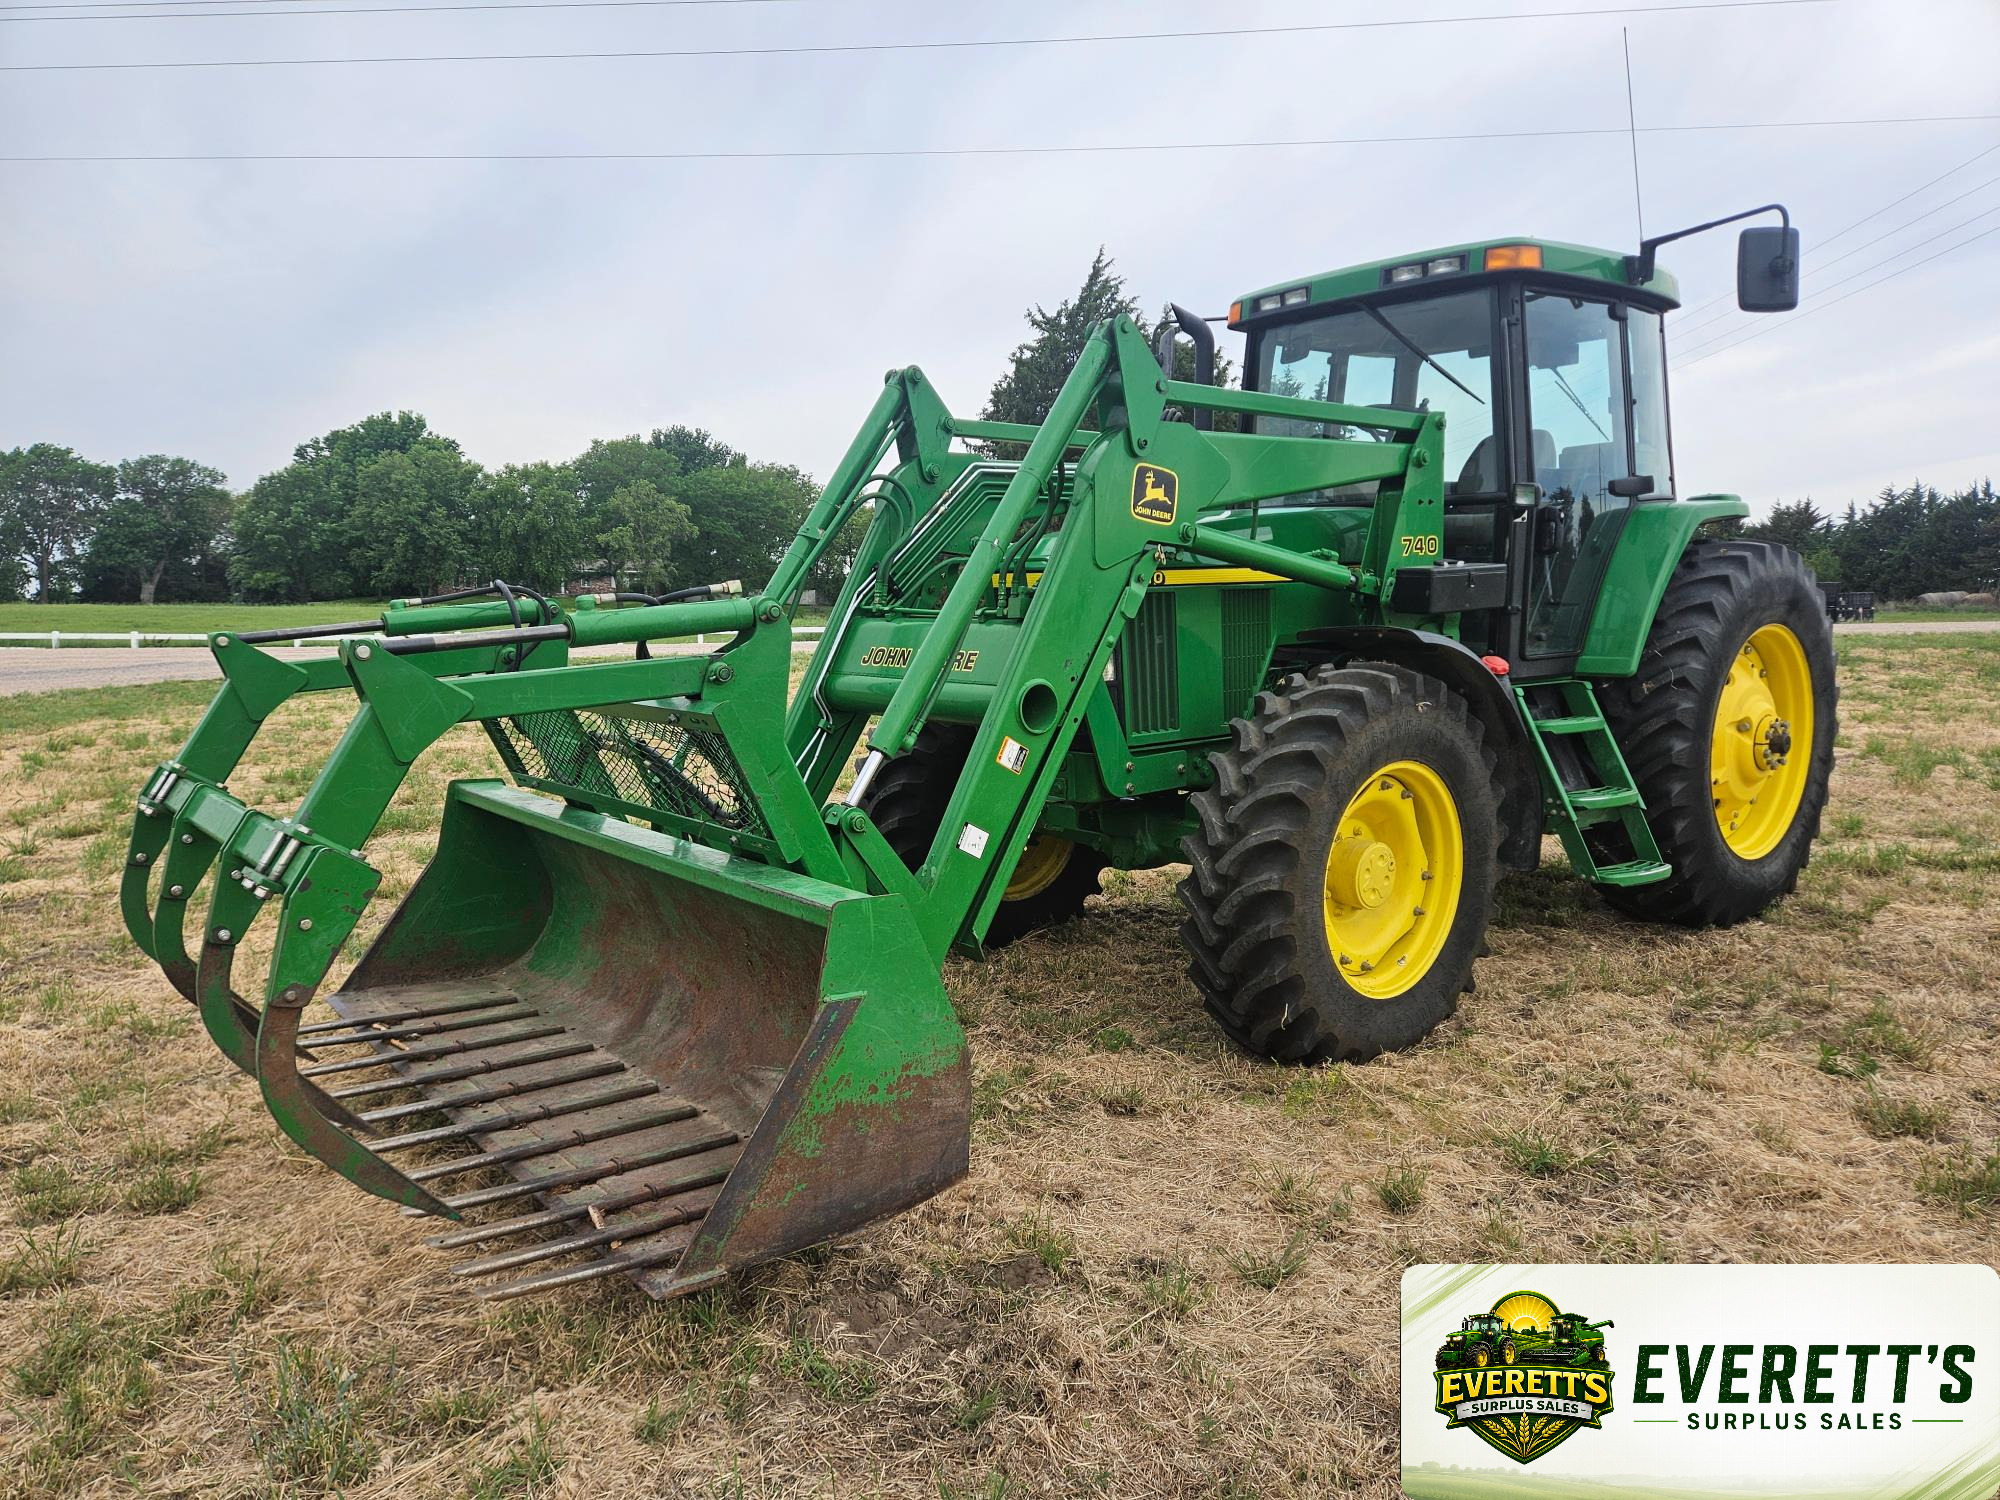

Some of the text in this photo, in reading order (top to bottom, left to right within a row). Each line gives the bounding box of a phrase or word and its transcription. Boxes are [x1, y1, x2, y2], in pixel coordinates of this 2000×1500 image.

[1134, 505, 1172, 520] JOHN DEERE
[1401, 535, 1439, 557] 740
[860, 646, 913, 668] JOHN
